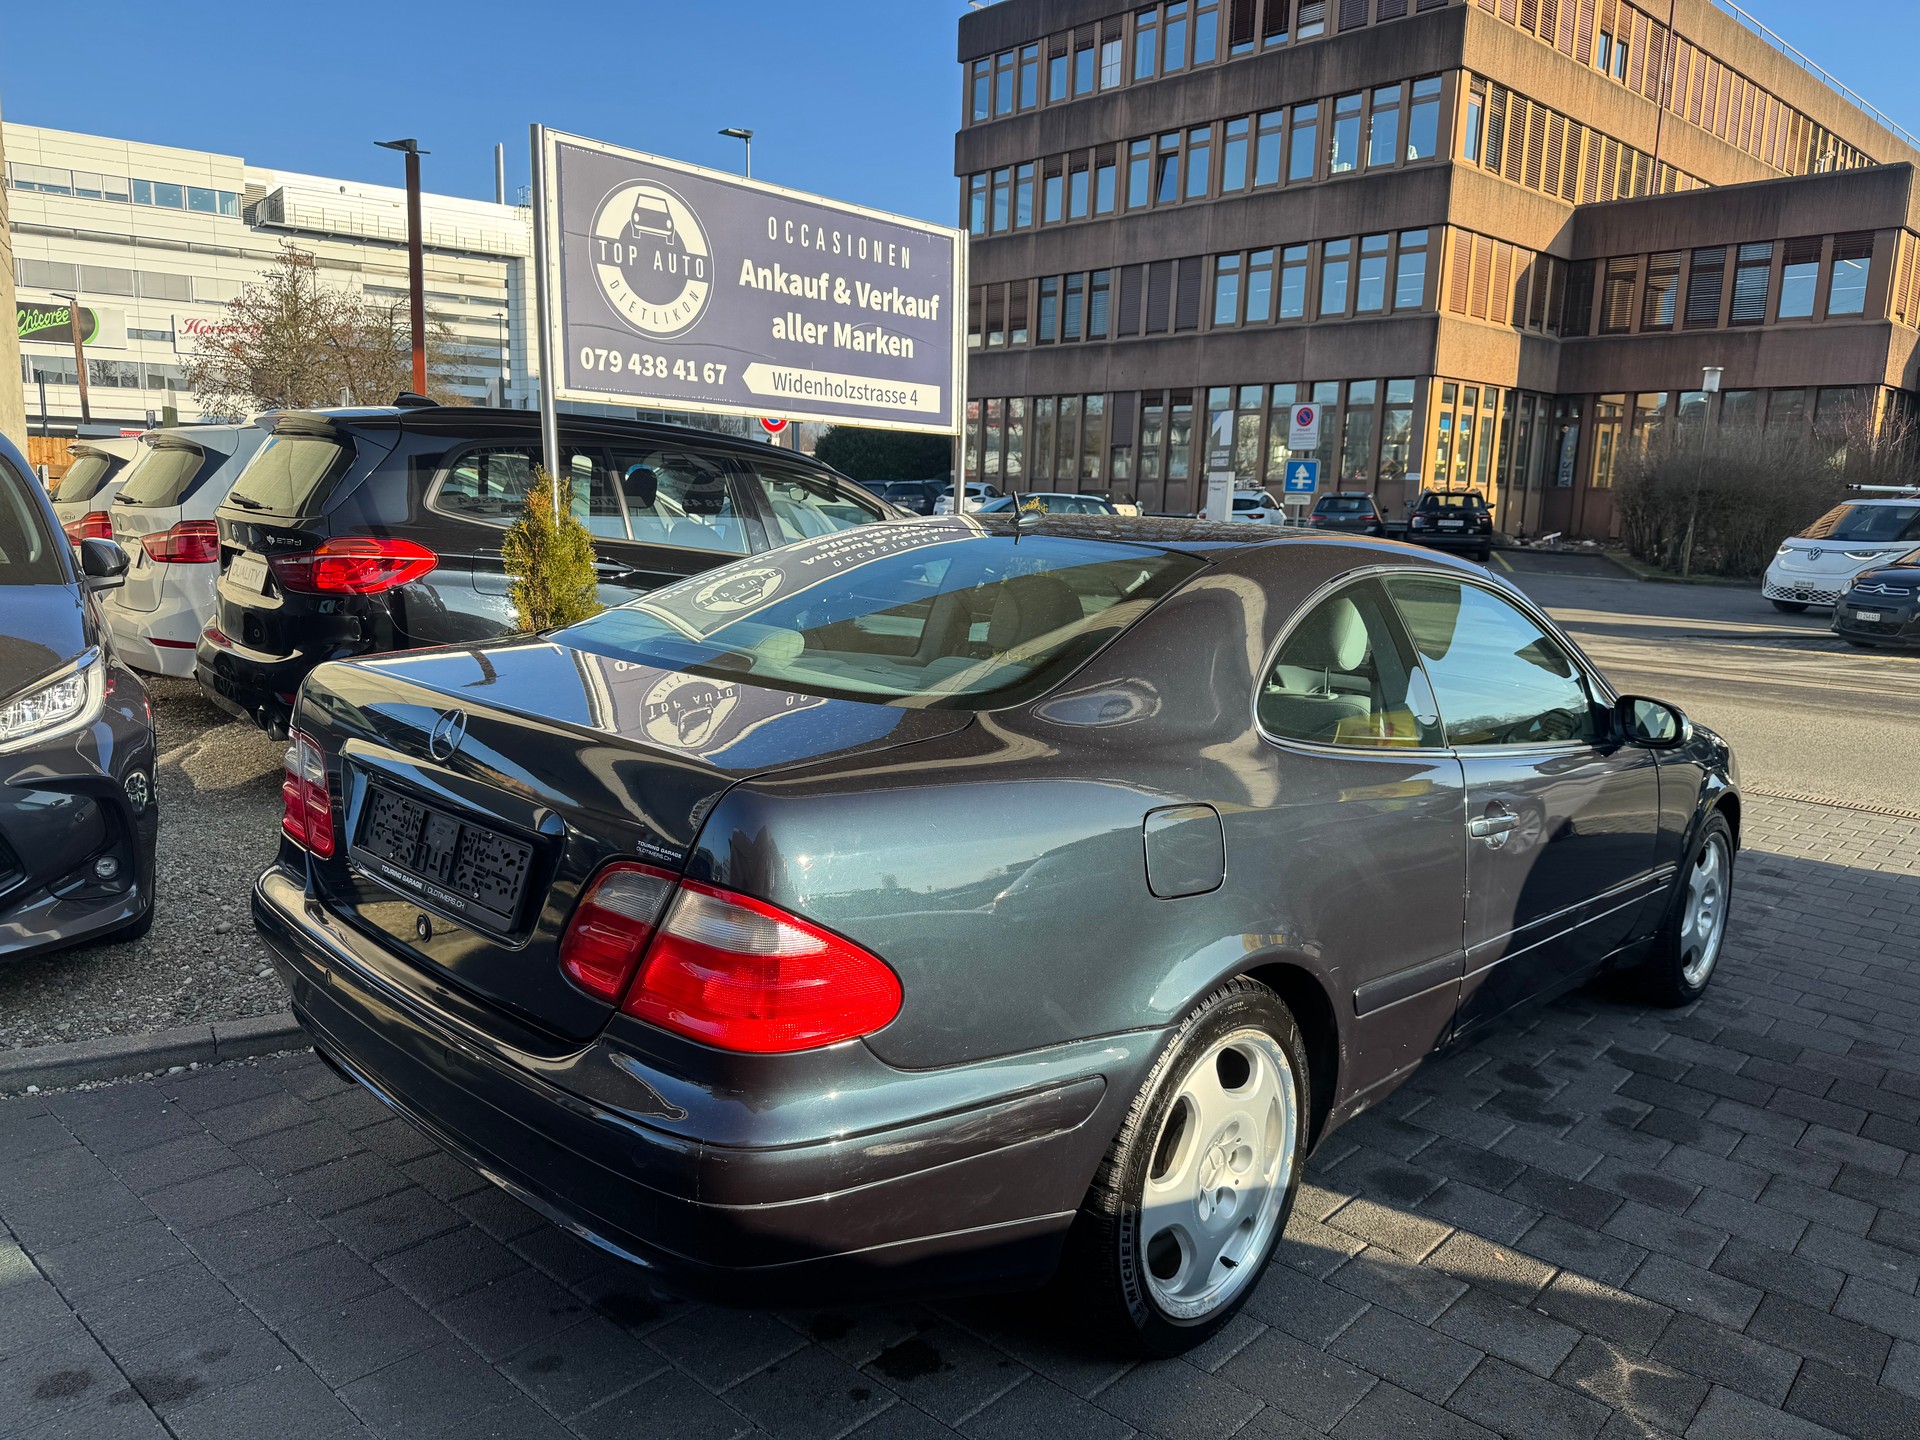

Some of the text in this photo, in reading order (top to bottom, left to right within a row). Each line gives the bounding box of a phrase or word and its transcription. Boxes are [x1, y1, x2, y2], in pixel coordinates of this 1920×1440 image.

[598, 239, 705, 279] TOP AUTO
[768, 216, 911, 270] OCCASIONEN
[609, 278, 699, 326] DIETLIKON
[738, 259, 939, 321] Ankauf & Verkauf
[772, 312, 914, 360] aller Marken
[580, 347, 727, 385] 079 438 41 67
[772, 371, 918, 406] Widenholzstrasse 4
[636, 846, 672, 862] OLDTIMERS.CH
[638, 840, 682, 860] TOURING GARAGE
[381, 864, 465, 909] TOURING GARAGE OLDTIMERS.CH
[1121, 1208, 1138, 1304] MICHELIN
